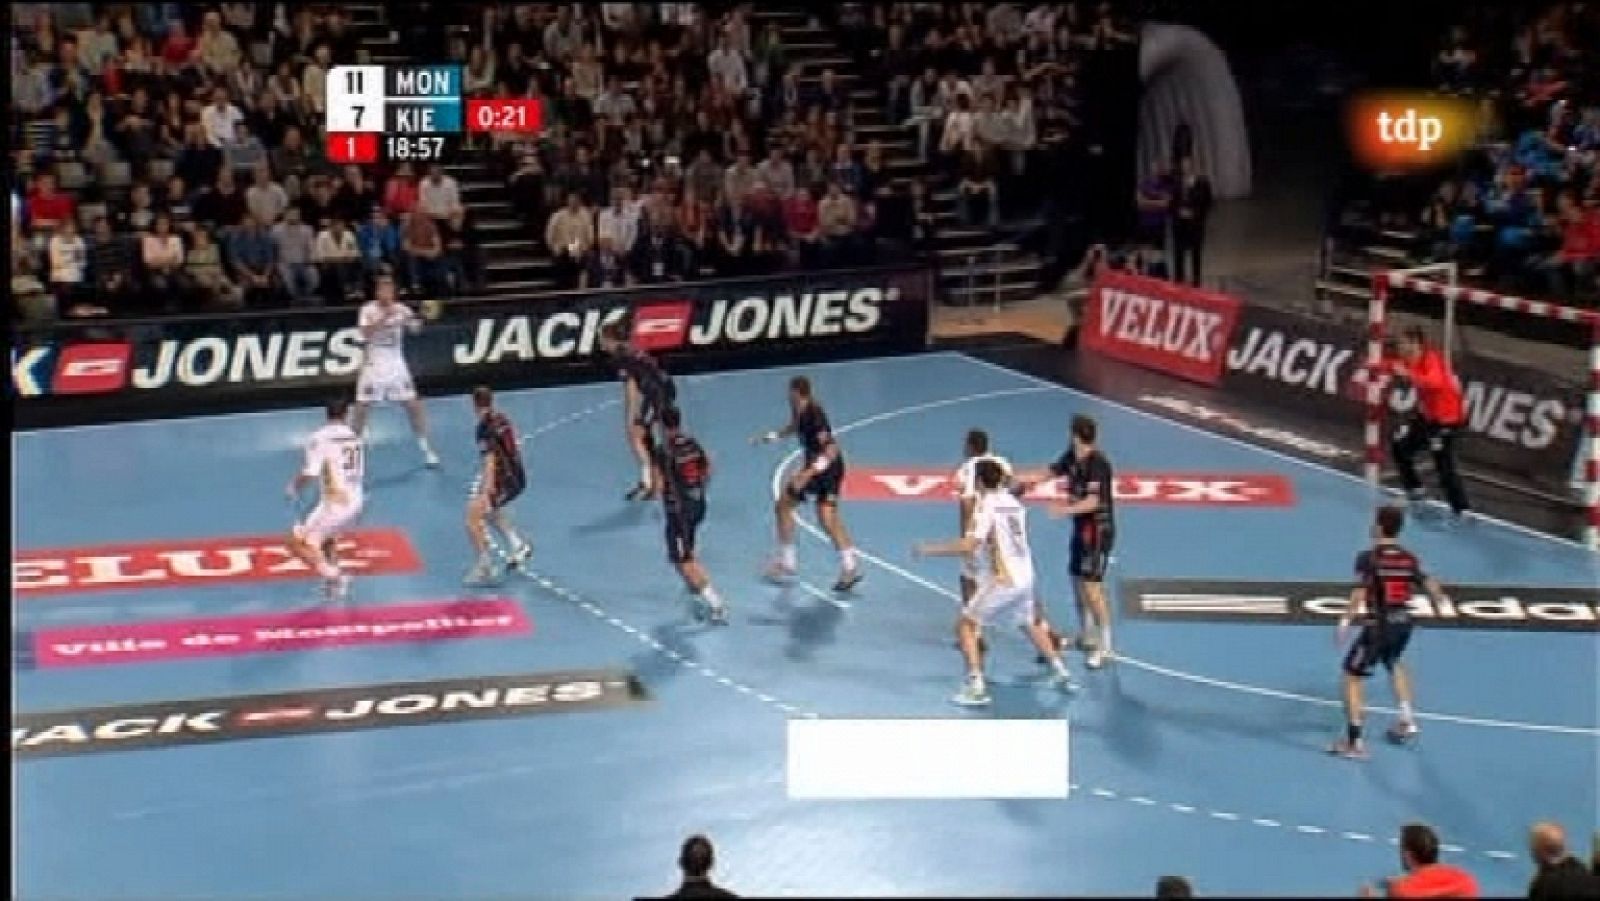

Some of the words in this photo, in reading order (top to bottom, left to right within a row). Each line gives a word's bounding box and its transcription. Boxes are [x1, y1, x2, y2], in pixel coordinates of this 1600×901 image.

[453, 306, 627, 364] JACK
[690, 287, 882, 345] JONES
[1100, 287, 1223, 363] VELUX
[131, 327, 366, 389] JONES
[1227, 326, 1353, 394] JACK
[181, 633, 242, 646] de
[324, 681, 602, 721] JONES
